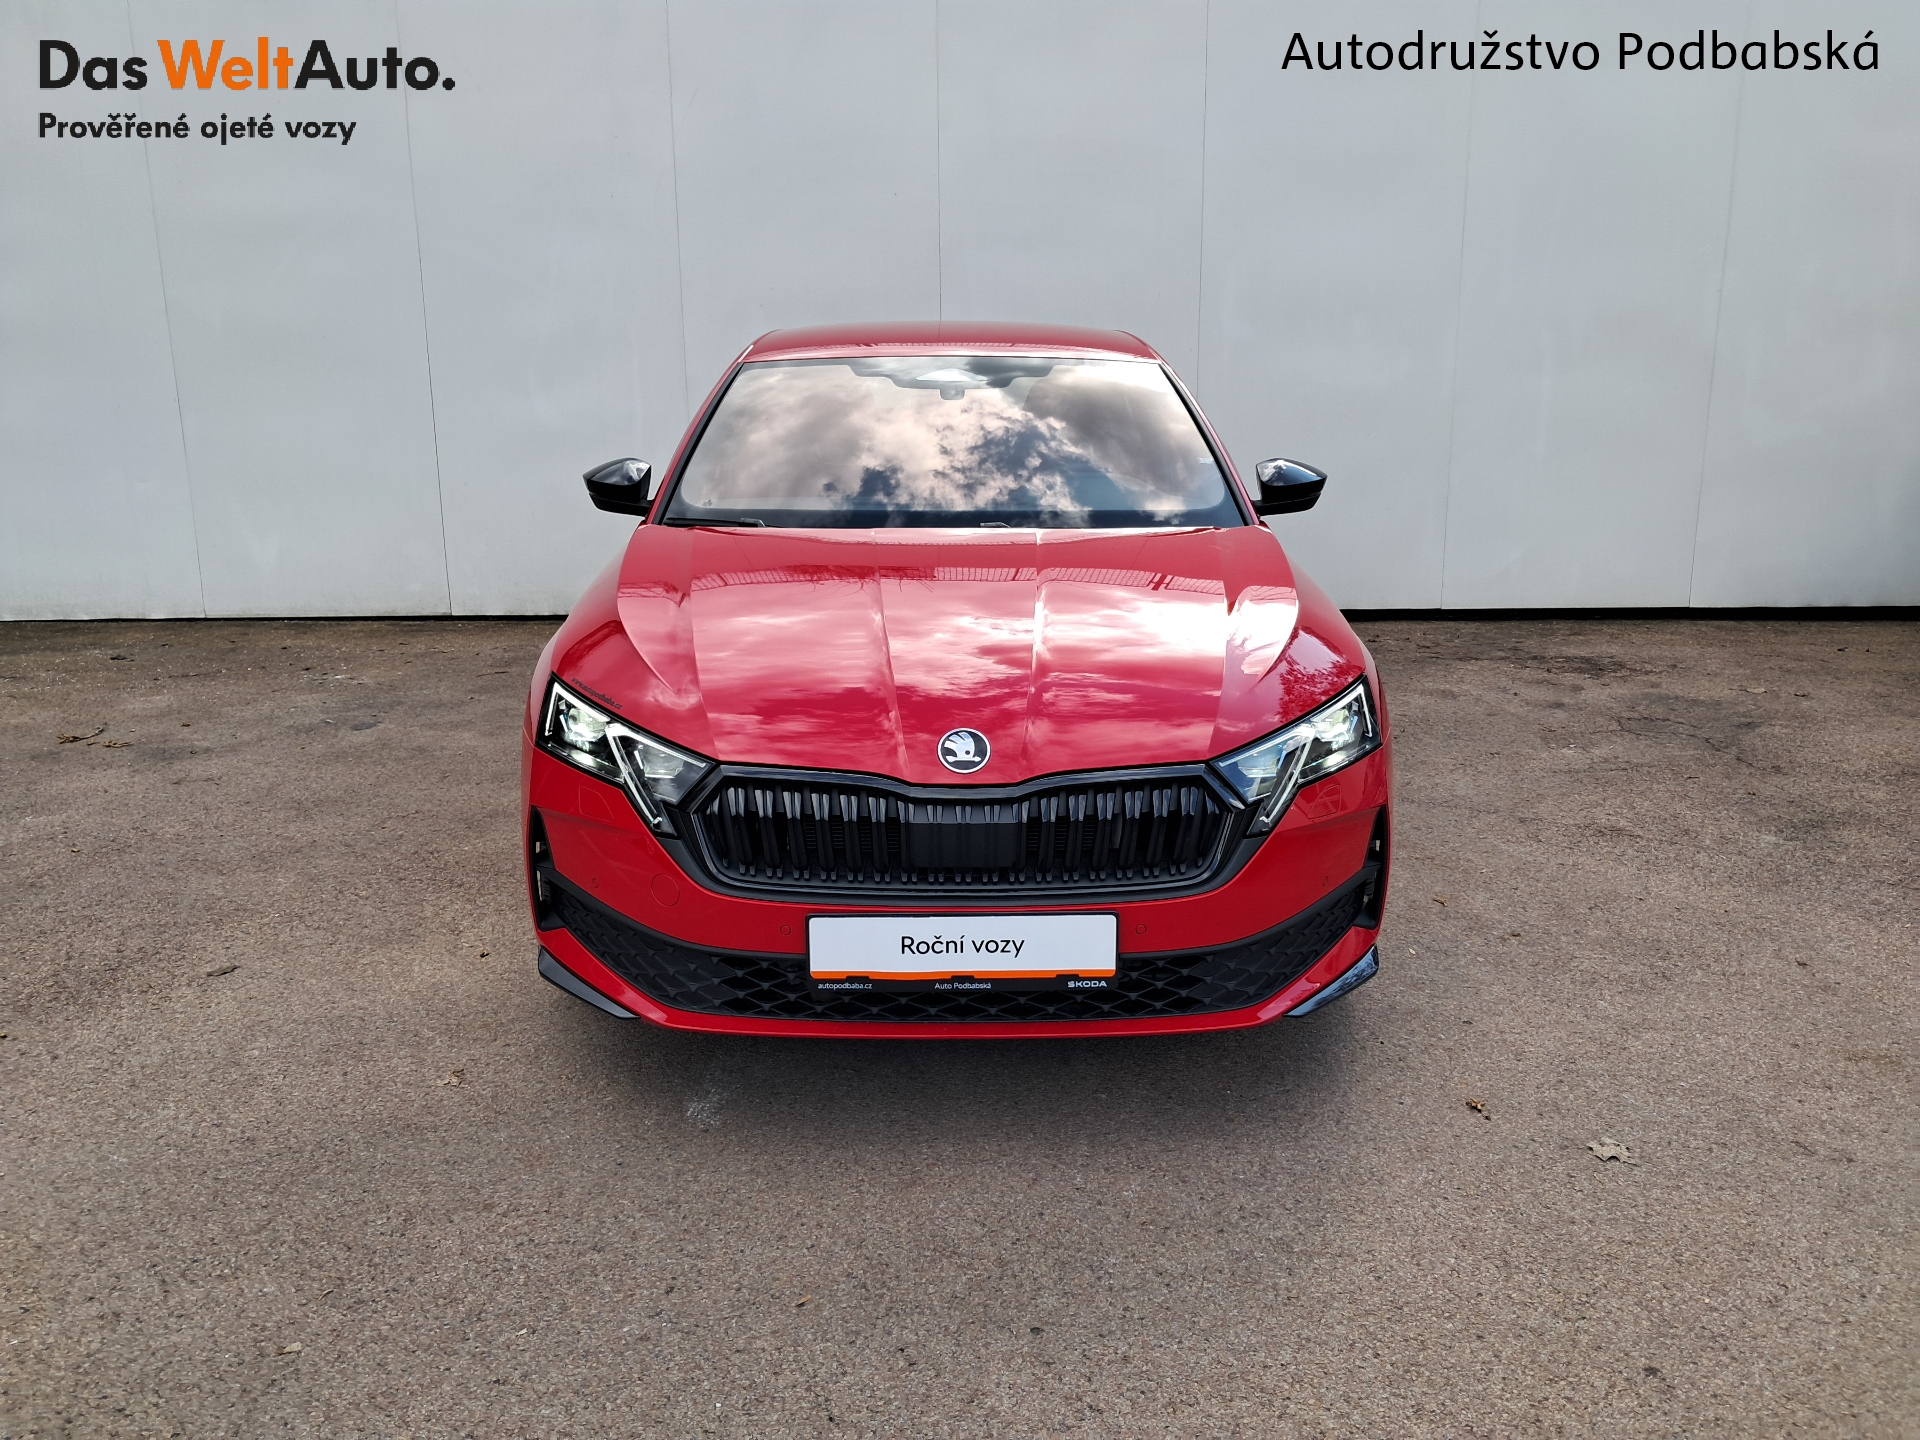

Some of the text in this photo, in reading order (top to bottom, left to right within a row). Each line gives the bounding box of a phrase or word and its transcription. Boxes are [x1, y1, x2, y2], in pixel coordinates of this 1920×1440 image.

[901, 935, 1025, 958] Roční vozy
[817, 982, 873, 990] autopodbaba.cz
[953, 981, 991, 989] Podbabská
